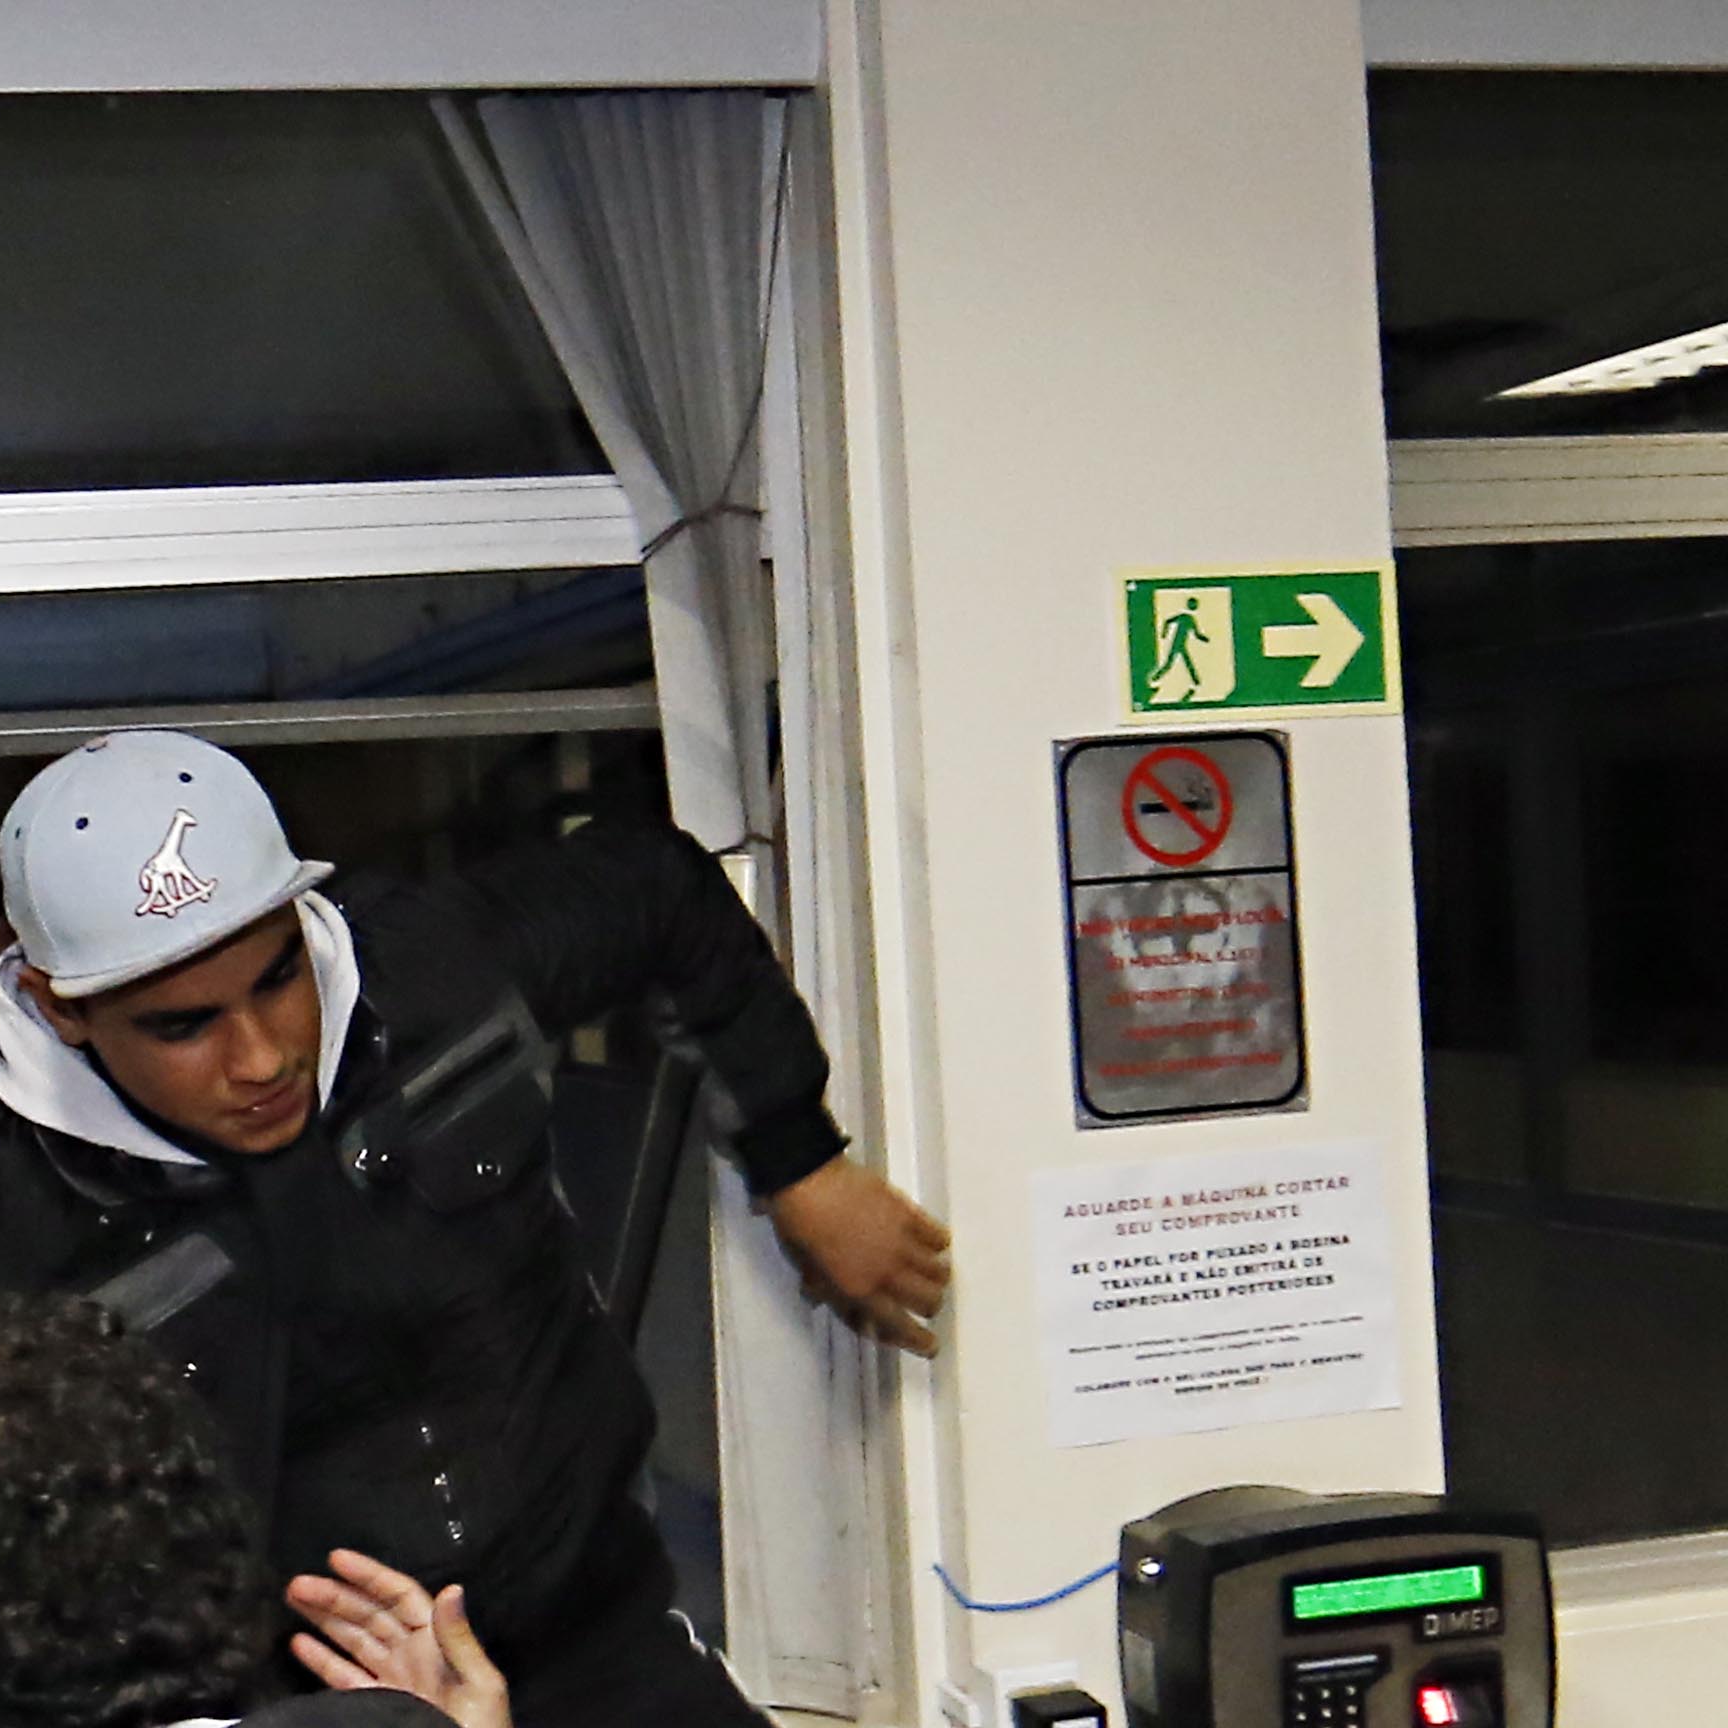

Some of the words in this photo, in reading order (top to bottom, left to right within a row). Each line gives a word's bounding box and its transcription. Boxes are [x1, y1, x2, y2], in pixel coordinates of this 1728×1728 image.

[1063, 1197, 1153, 1218] AGUARDE
[1162, 1195, 1173, 1208] A
[1275, 1176, 1350, 1195] CORTAR
[1115, 1221, 1152, 1236] SEU
[1162, 1204, 1301, 1231] COMPROVANTE
[1071, 1263, 1090, 1275] SE
[1097, 1261, 1107, 1272] O
[1114, 1255, 1162, 1270] PAPEL
[1169, 1250, 1199, 1263] FOR
[1206, 1243, 1268, 1259] PUXADO
[1275, 1241, 1284, 1251] A
[1180, 1272, 1188, 1282] E
[1092, 1288, 1221, 1312] COMPROVANTES
[1423, 1606, 1499, 1637] DIMEP
